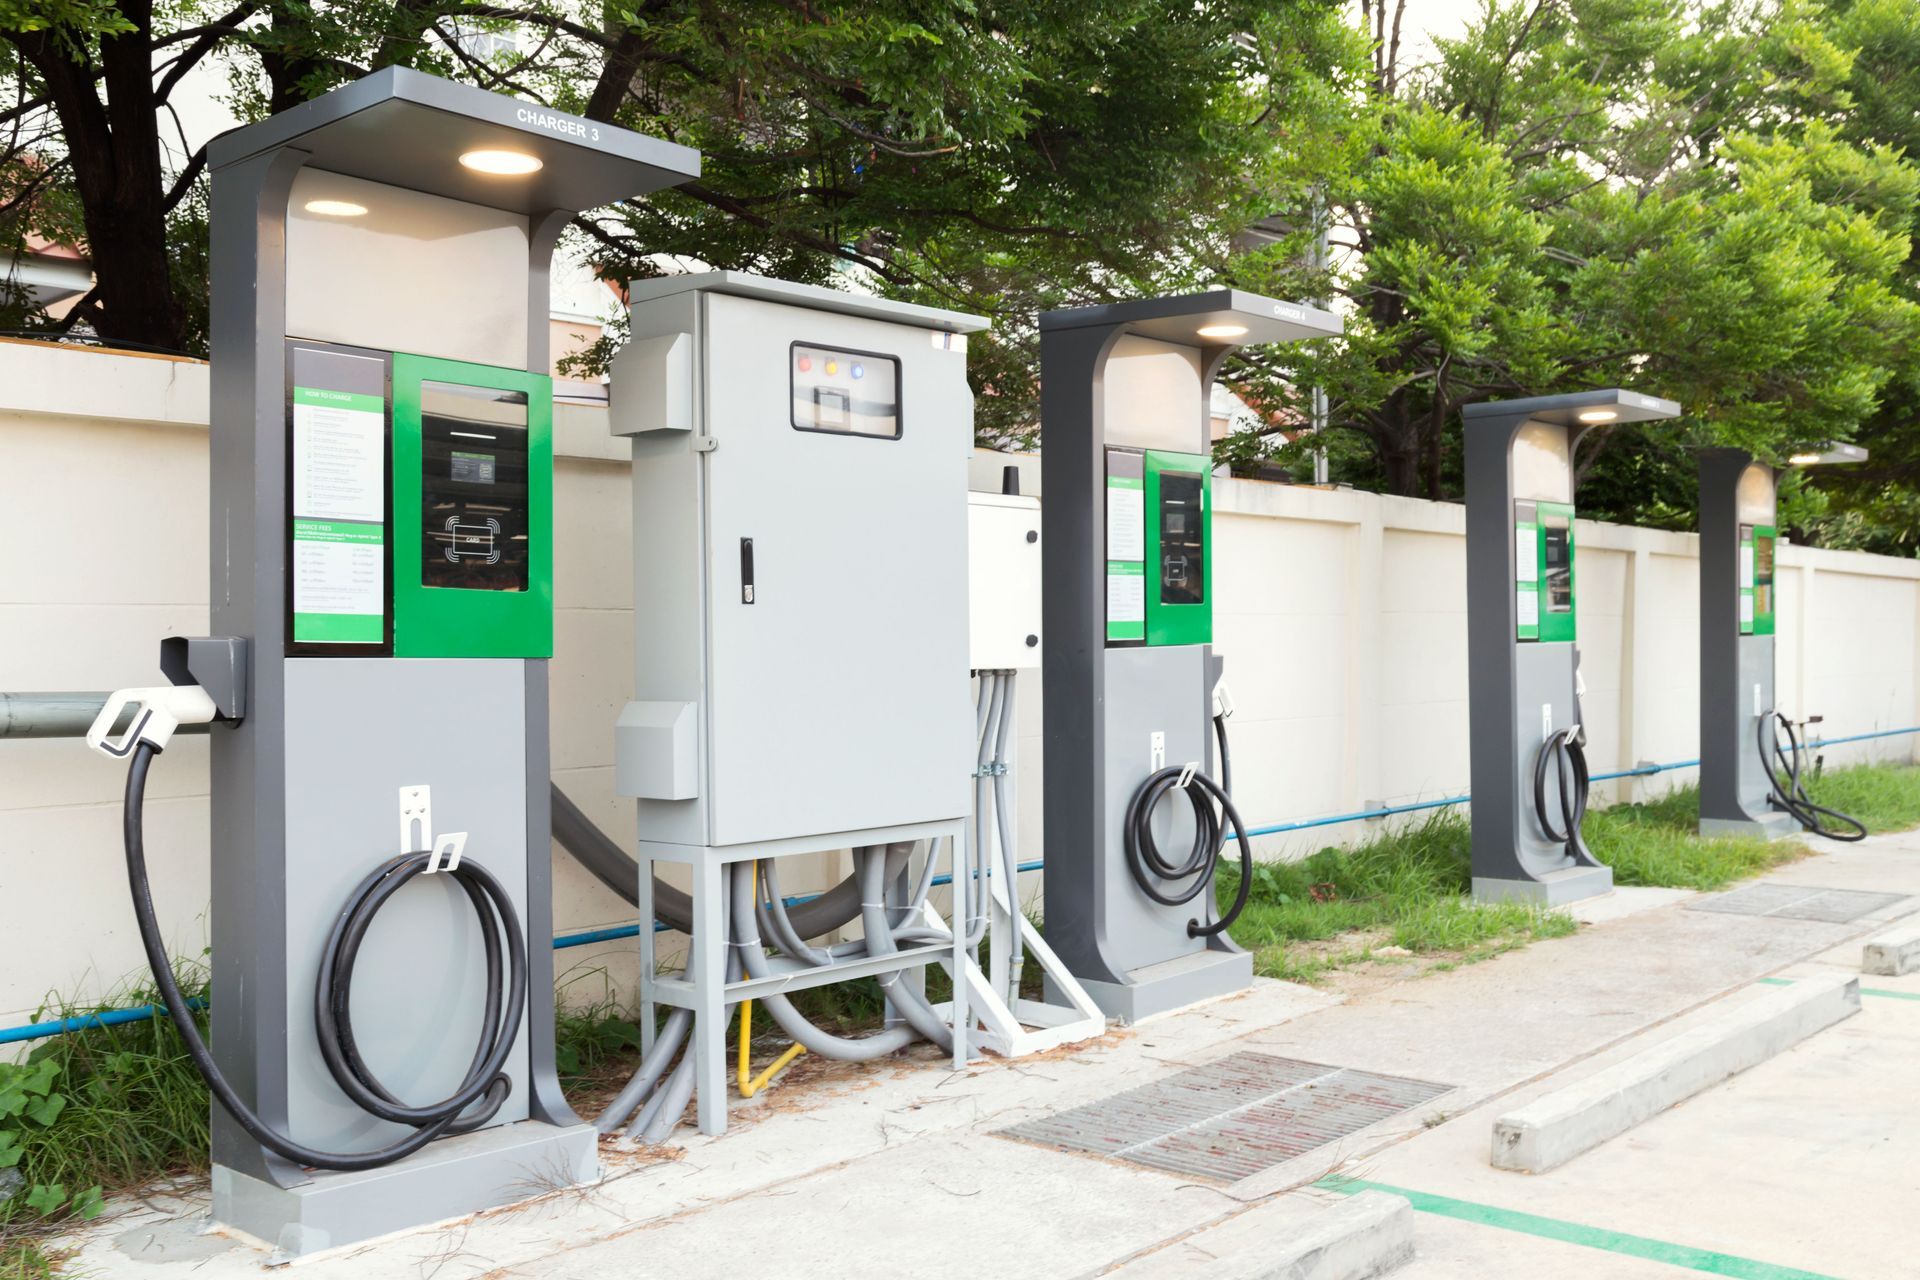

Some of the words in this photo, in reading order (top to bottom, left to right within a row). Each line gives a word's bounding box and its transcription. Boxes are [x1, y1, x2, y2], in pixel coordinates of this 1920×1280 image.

[517, 108, 587, 138] CHARGER
[591, 127, 600, 142] 3
[304, 390, 320, 398] HOW
[320, 391, 329, 400] TO
[328, 392, 353, 402] CHARGE
[295, 523, 318, 531] SERVICE
[318, 524, 332, 532] FEES
